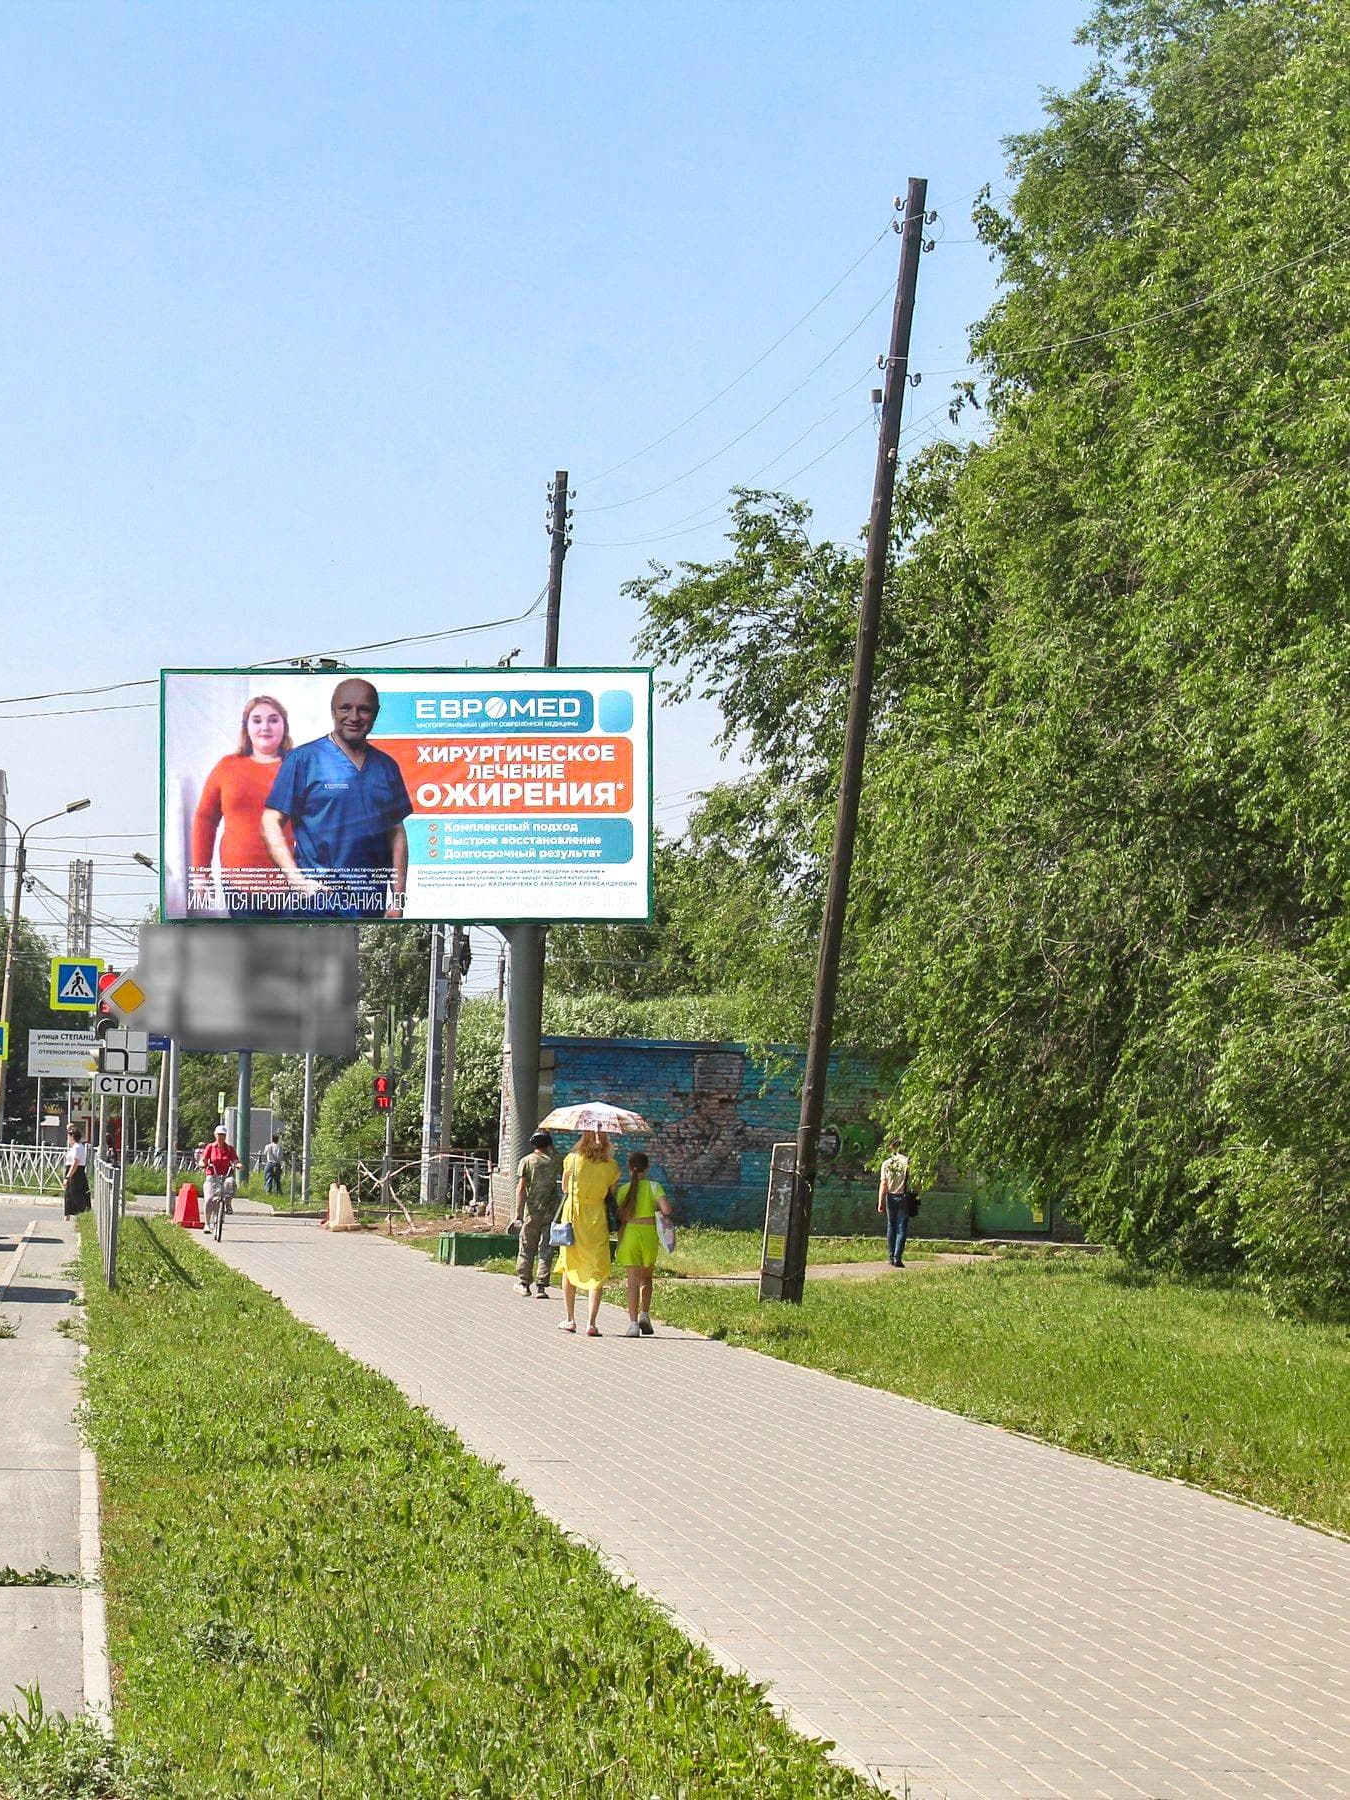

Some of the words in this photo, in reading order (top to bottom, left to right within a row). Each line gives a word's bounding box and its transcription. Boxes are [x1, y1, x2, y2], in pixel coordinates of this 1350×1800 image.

[417, 745, 615, 762] ХИРУРГИЧЕСКОЕ
[467, 764, 565, 779] ЛЕЧЕНИЕ
[444, 821, 530, 832] Комплексный
[533, 823, 578, 833] подход
[444, 836, 498, 846] Быстрое
[502, 836, 601, 845] восстановление
[444, 849, 535, 860] Долгосрочный
[540, 850, 601, 860] результат
[251, 891, 384, 911] ПРОТИВОПОКАЗАНИЯ
[100, 1077, 152, 1094] СТОП
